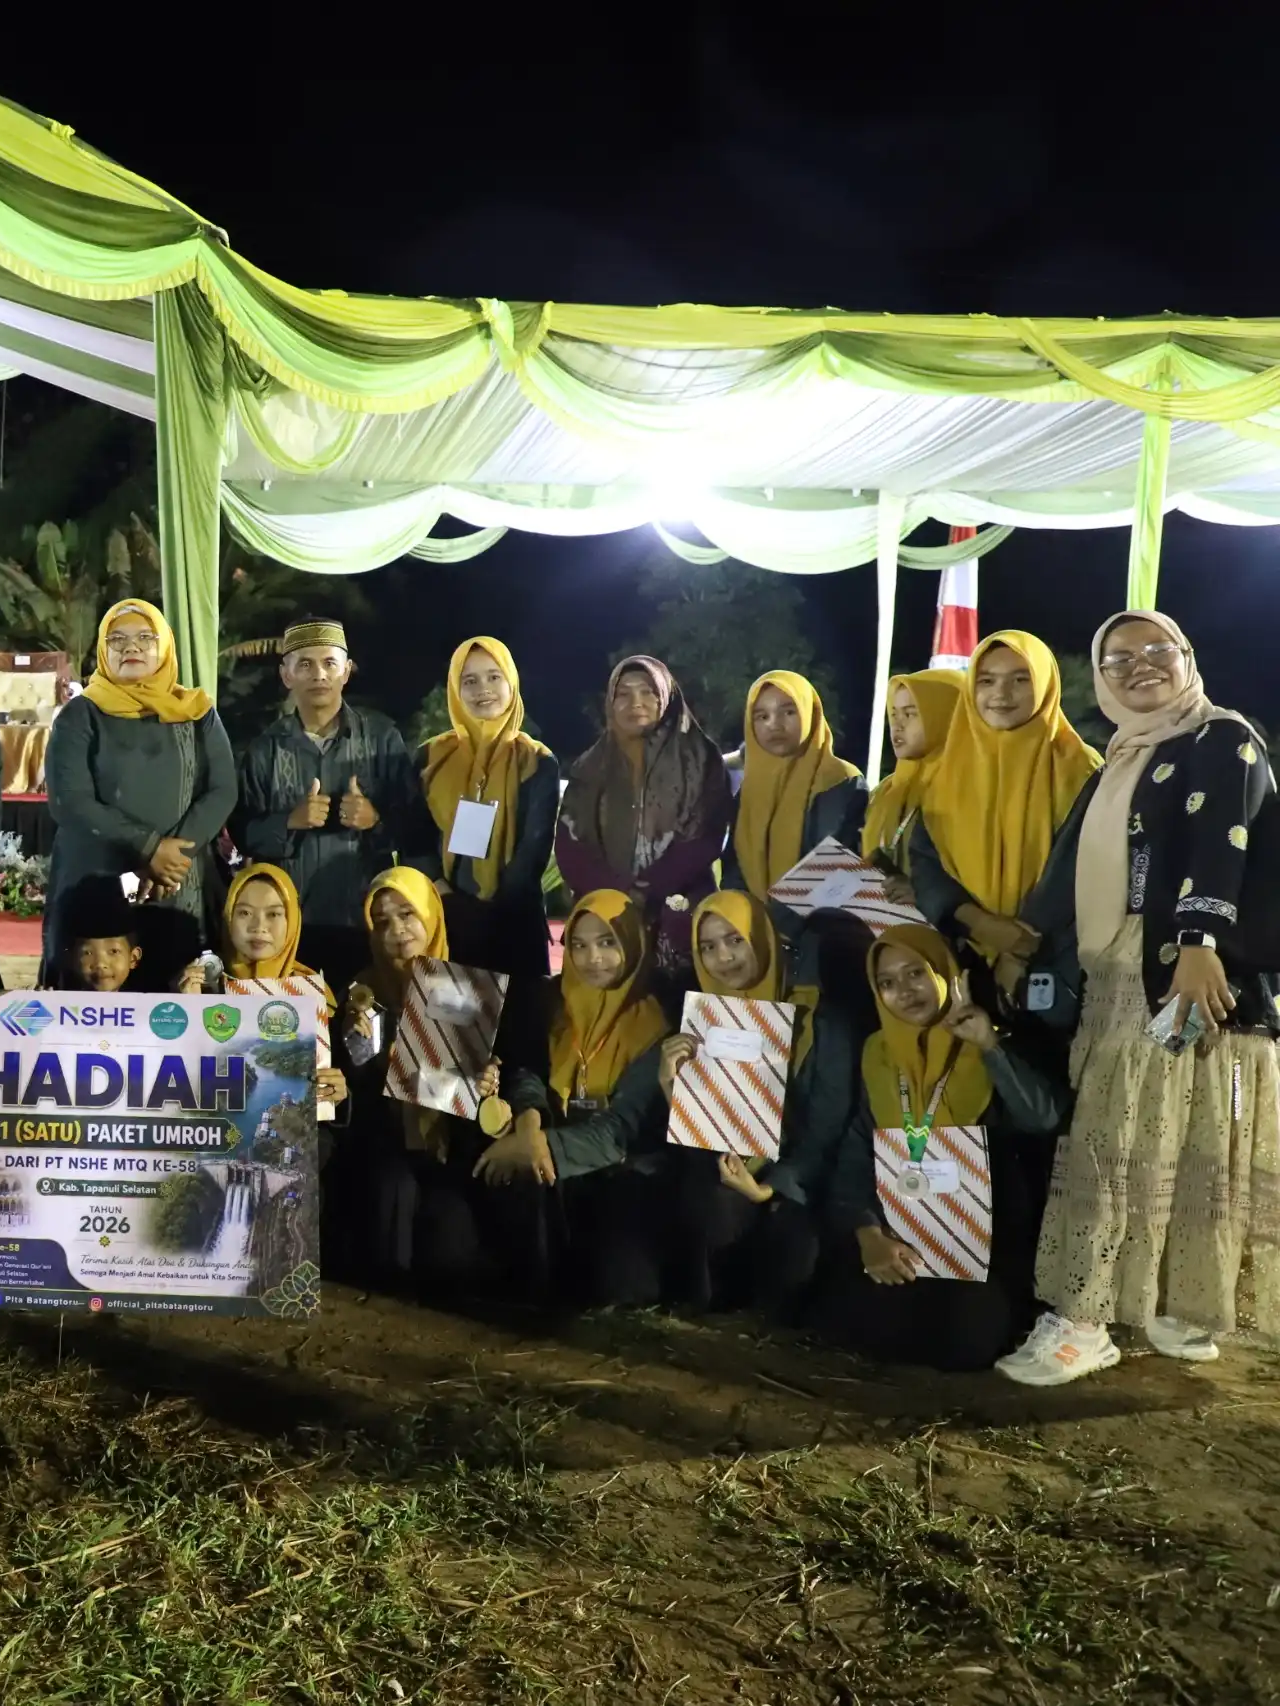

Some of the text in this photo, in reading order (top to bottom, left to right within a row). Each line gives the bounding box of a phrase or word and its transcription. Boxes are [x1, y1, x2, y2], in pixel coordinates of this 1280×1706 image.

[60, 1006, 135, 1027] NSHE
[0, 1119, 221, 1146] 1 (SATU) PAKET UMROH
[5, 1155, 196, 1173] DARI PT NSHE MTQ KE-58
[58, 1182, 157, 1195] Kab. Tapanuli Selatan
[89, 1205, 122, 1214] TAHUN
[79, 1216, 130, 1234] 2026
[80, 1254, 108, 1265] Terima
[110, 1255, 134, 1265] Kasih
[177, 1257, 185, 1268] &
[80, 1268, 107, 1278] Semoga
[108, 1269, 136, 1278] Menjadi
[137, 1270, 156, 1278] Amal
[157, 1271, 188, 1279] Kebaikan
[189, 1272, 210, 1280] untuk
[227, 1273, 251, 1281] Semua
